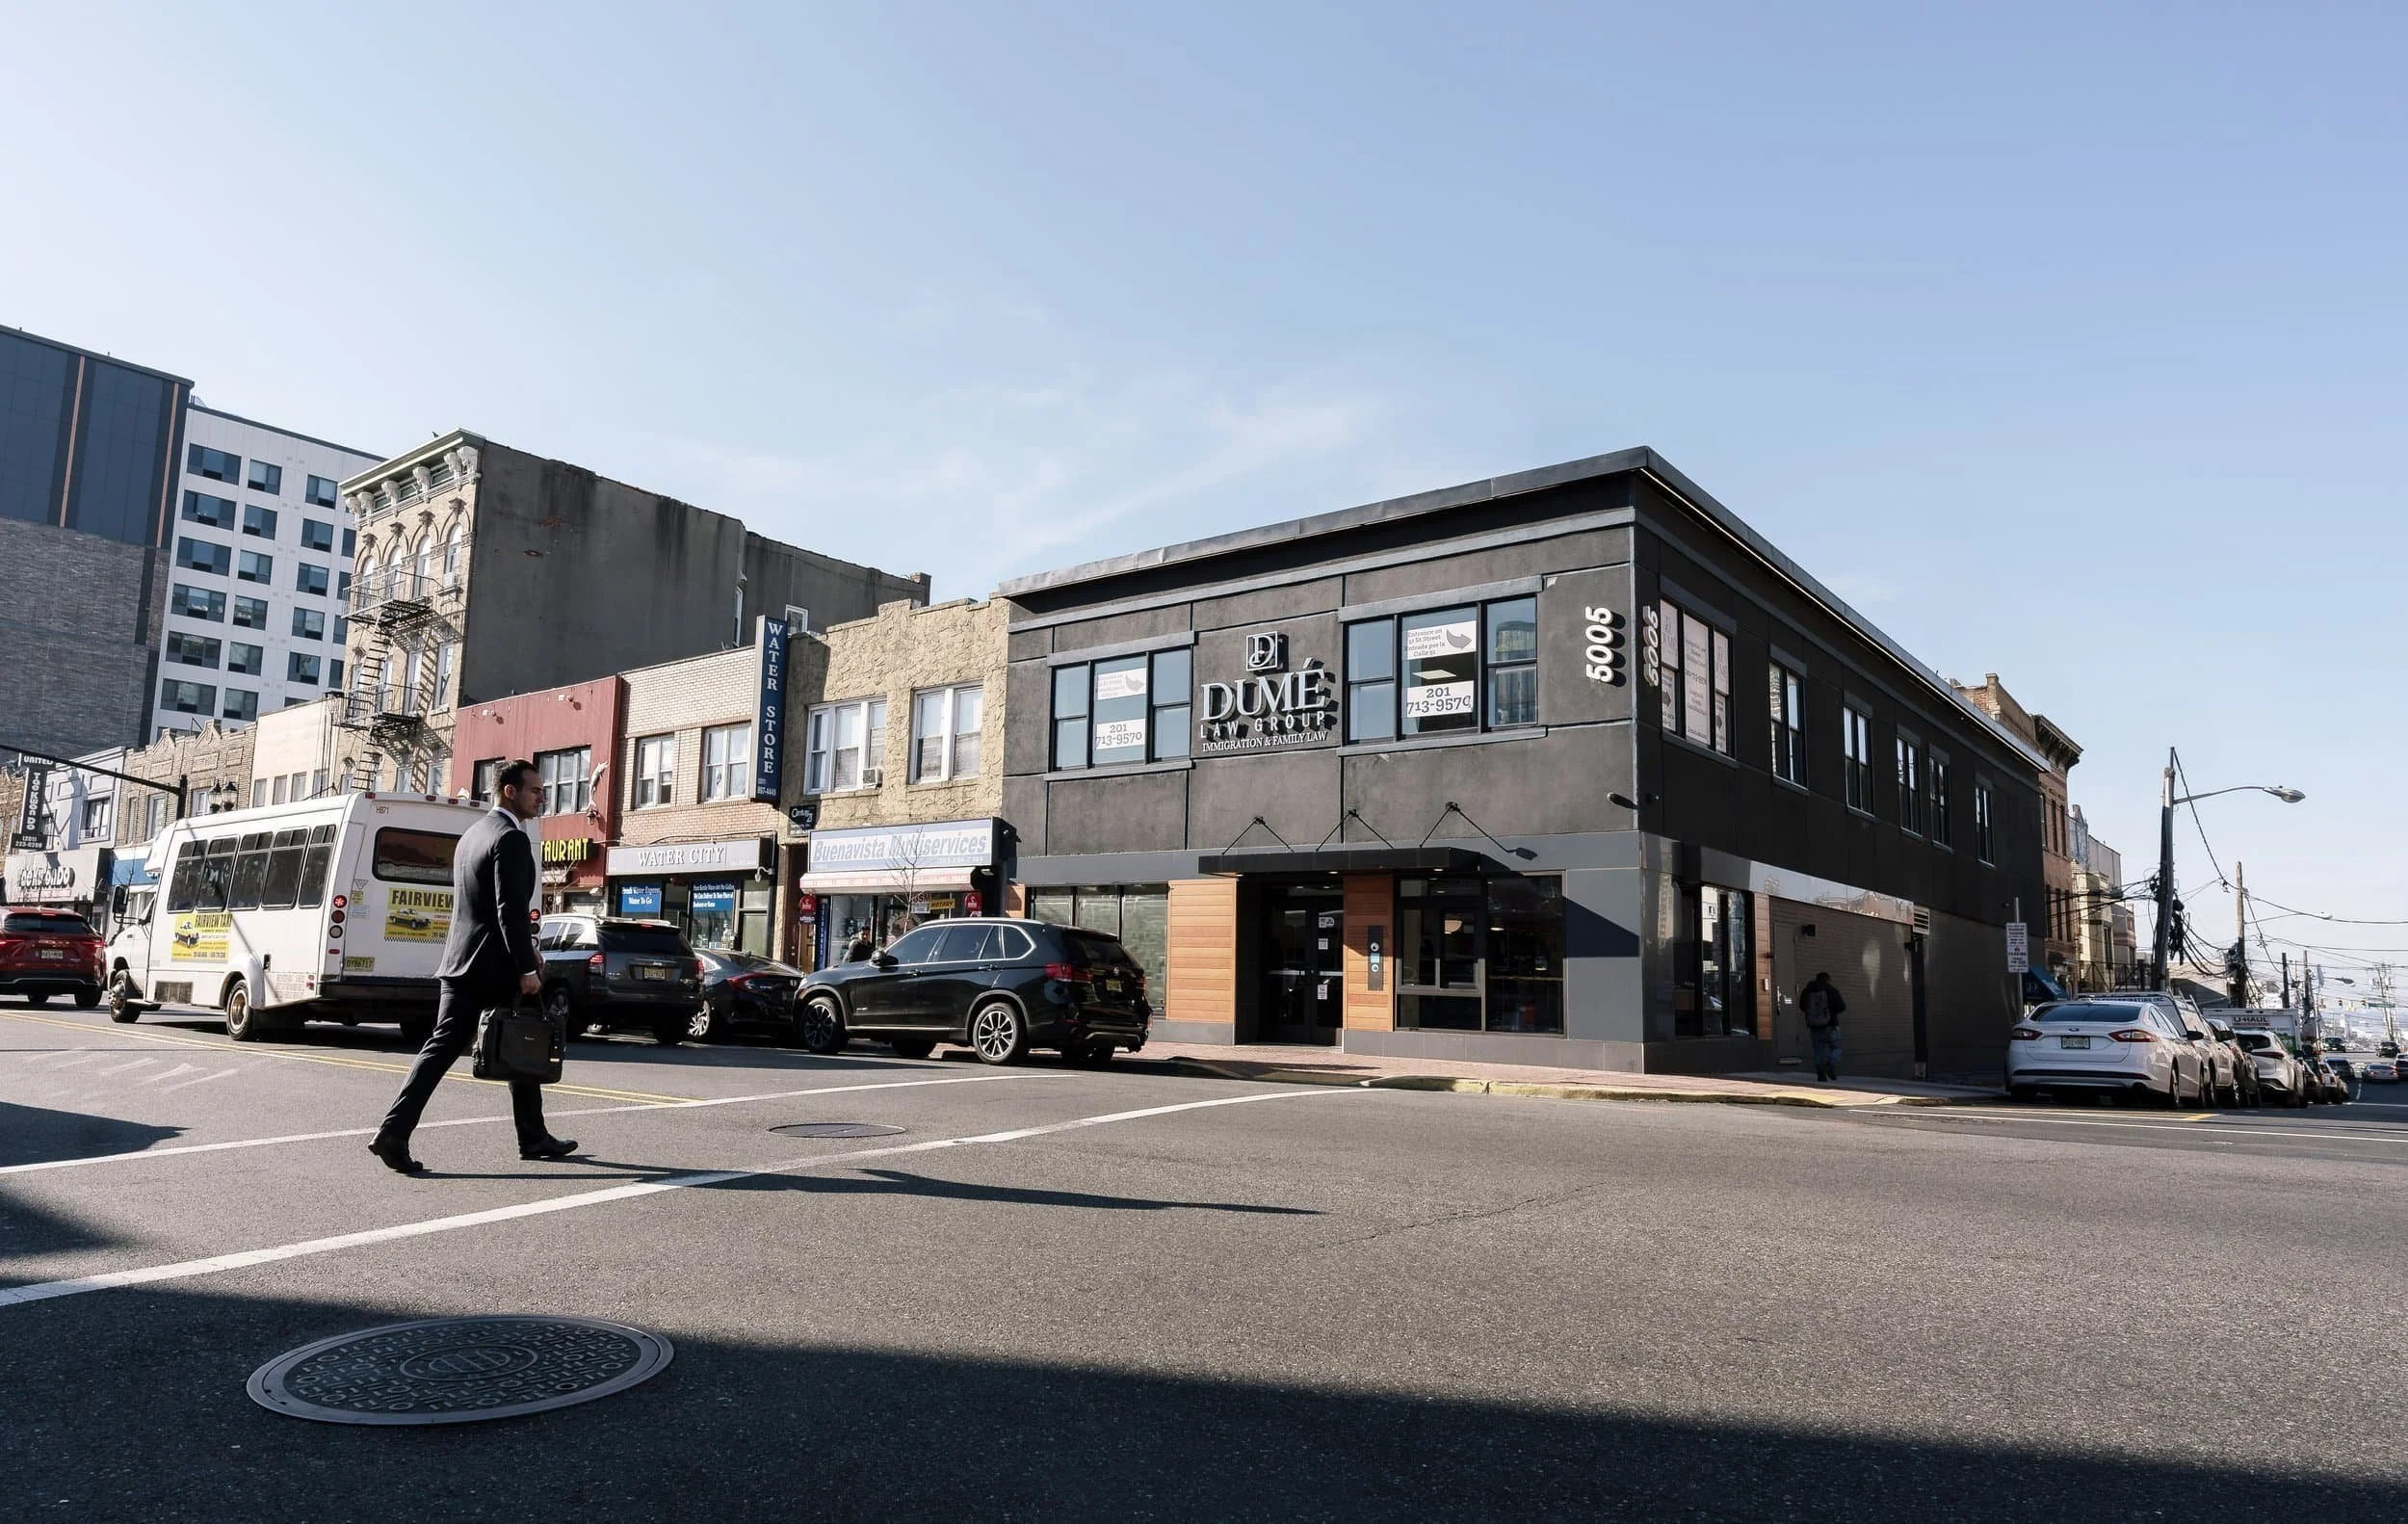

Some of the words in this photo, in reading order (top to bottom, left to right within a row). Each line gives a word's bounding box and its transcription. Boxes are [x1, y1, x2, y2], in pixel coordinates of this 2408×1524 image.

[1585, 606, 1613, 682] 5005
[1642, 605, 1659, 686] 5005
[767, 622, 783, 691] WATER
[1201, 657, 1325, 721] DUMÉ
[1426, 687, 1451, 698] 201
[1110, 723, 1128, 733] 201
[1201, 721, 1239, 738] LAW
[1254, 711, 1325, 732] GROUP
[764, 706, 776, 774] STORE
[1095, 732, 1142, 746] 713-9570
[1202, 737, 1263, 752] IMMIGRATION
[1273, 733, 1304, 746] FAMILY
[1306, 730, 1327, 741] LAW
[539, 838, 589, 862] TAURANT
[638, 849, 685, 867] WATER
[689, 847, 725, 864] CITY
[814, 837, 885, 861] Buenavista
[392, 890, 455, 908] FAIRVIEW
